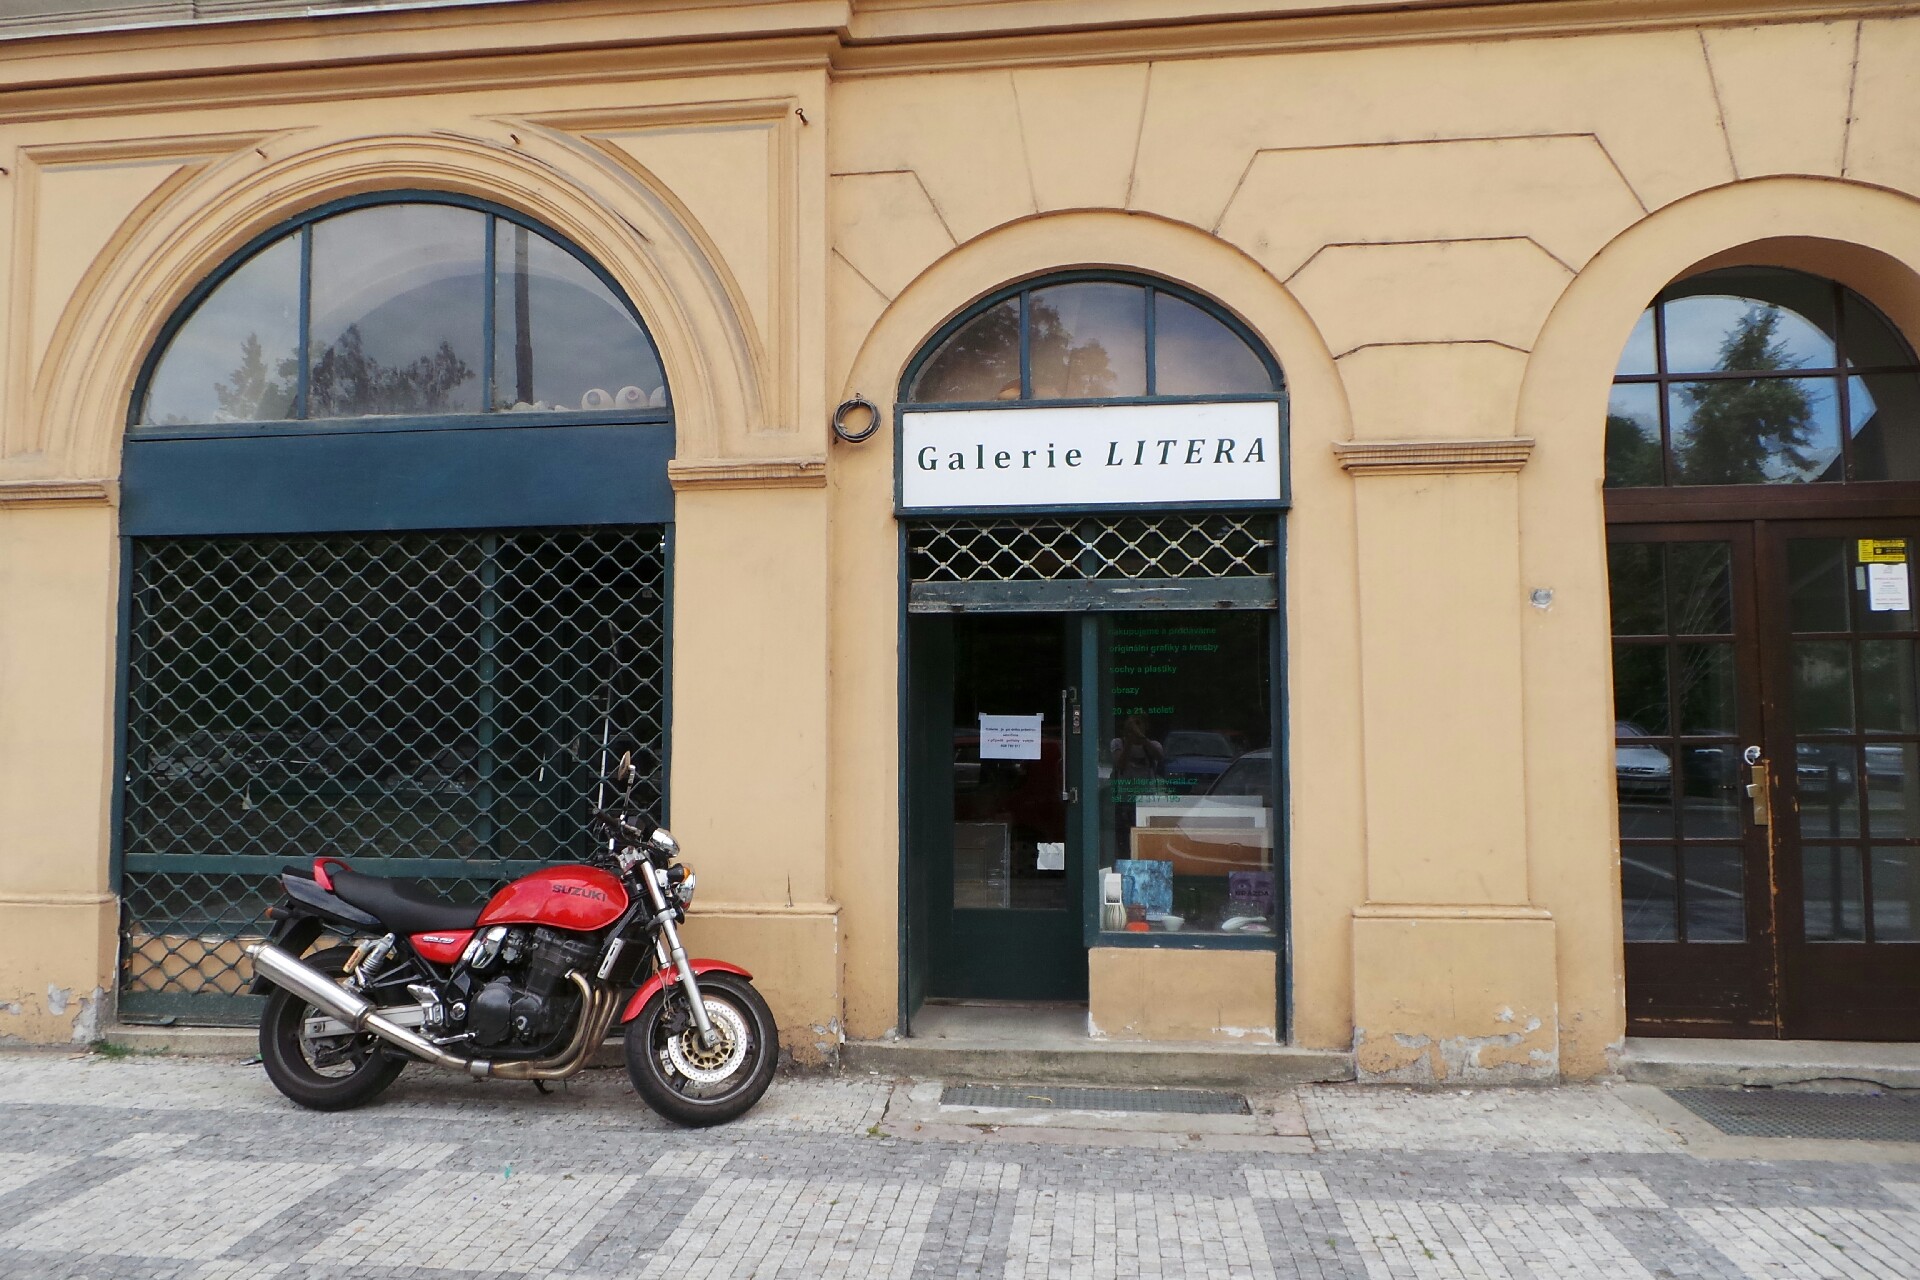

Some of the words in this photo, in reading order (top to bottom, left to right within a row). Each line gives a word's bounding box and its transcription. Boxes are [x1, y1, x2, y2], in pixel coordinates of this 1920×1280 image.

[917, 442, 1082, 471] Galerie
[1105, 437, 1266, 466] LITERA
[1150, 643, 1179, 653] grafiky
[1190, 643, 1219, 652] kresby
[1109, 665, 1134, 674] sochy
[1144, 664, 1177, 674] plastiky
[1111, 686, 1139, 695] obrazy
[552, 884, 606, 902] SUZUKI
